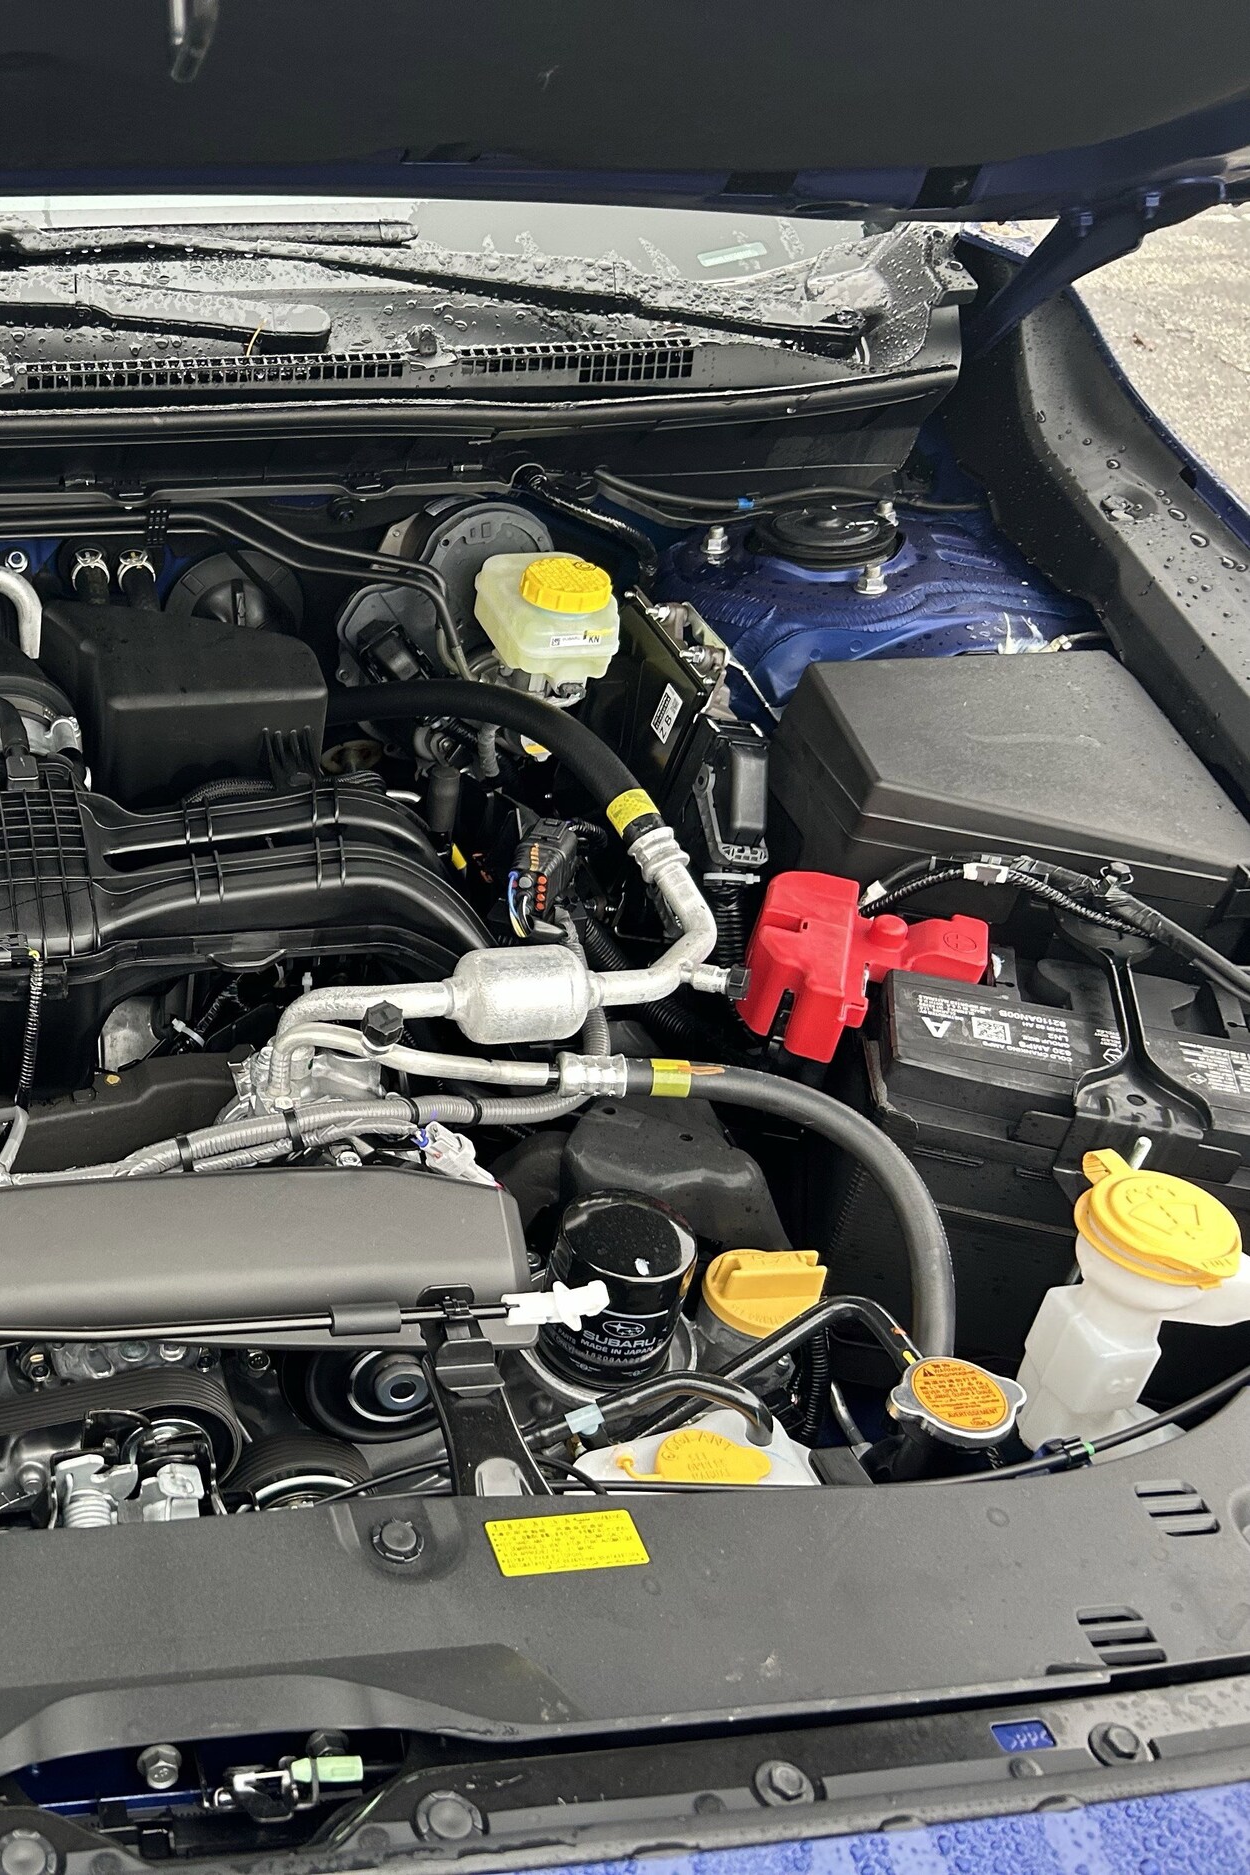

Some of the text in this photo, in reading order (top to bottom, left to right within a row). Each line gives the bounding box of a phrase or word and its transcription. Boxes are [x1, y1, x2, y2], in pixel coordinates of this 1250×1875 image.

[921, 1016, 951, 1038] A
[1047, 1032, 1069, 1042] LN2
[1006, 1045, 1049, 1058] CRANKING
[1018, 1041, 1072, 1056] 620 AMPS
[1049, 1054, 1073, 1062] COLD
[582, 1329, 656, 1348] SUBARU
[580, 1338, 608, 1353] MADE
[623, 1346, 654, 1355] JAPAN
